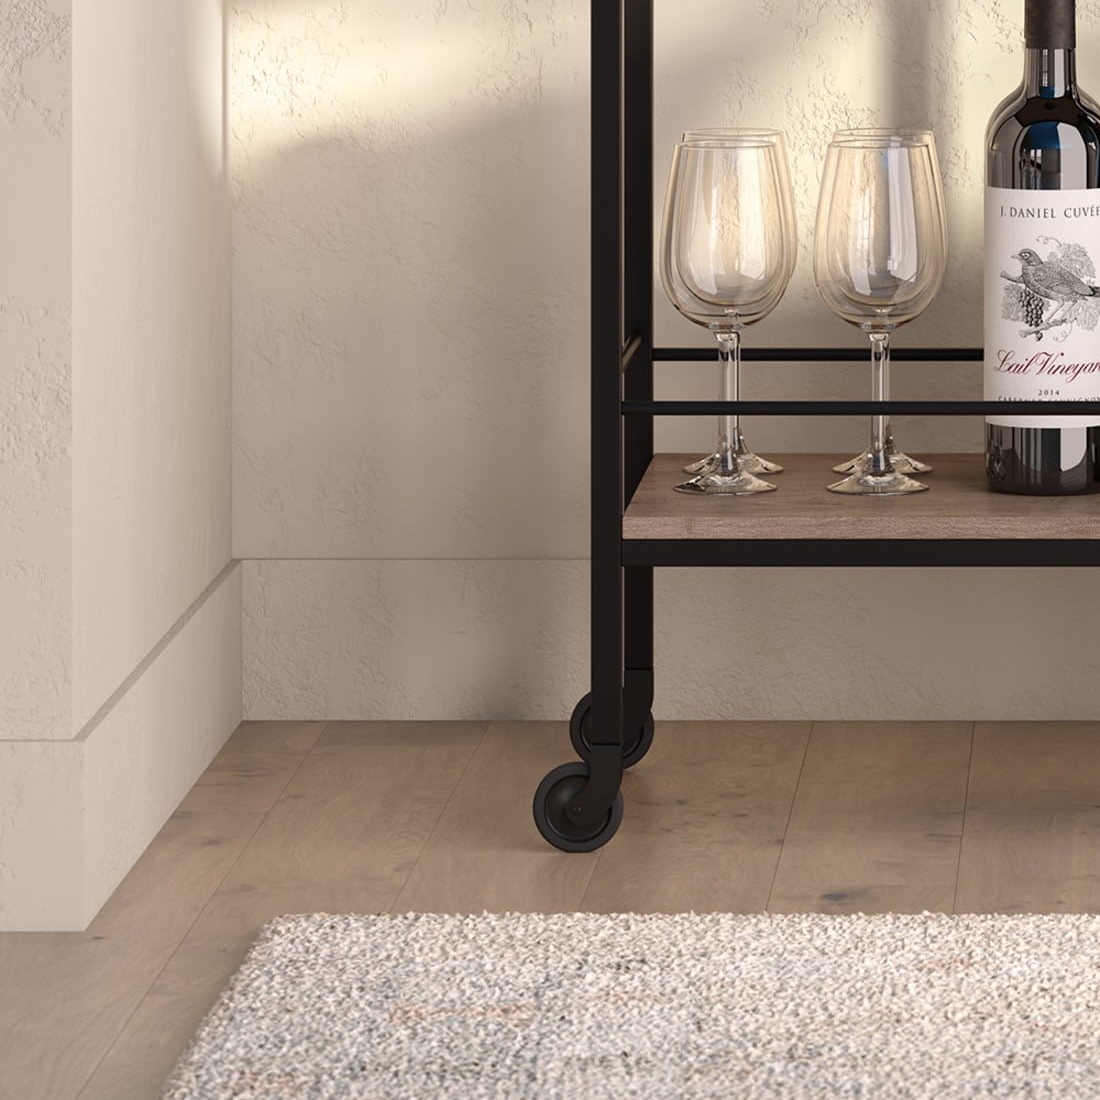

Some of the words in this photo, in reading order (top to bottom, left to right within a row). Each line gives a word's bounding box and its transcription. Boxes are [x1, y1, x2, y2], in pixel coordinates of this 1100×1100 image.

[1009, 206, 1057, 219] DANIEL
[1063, 204, 1100, 219] CUVÉE
[1038, 388, 1060, 396] 2014
